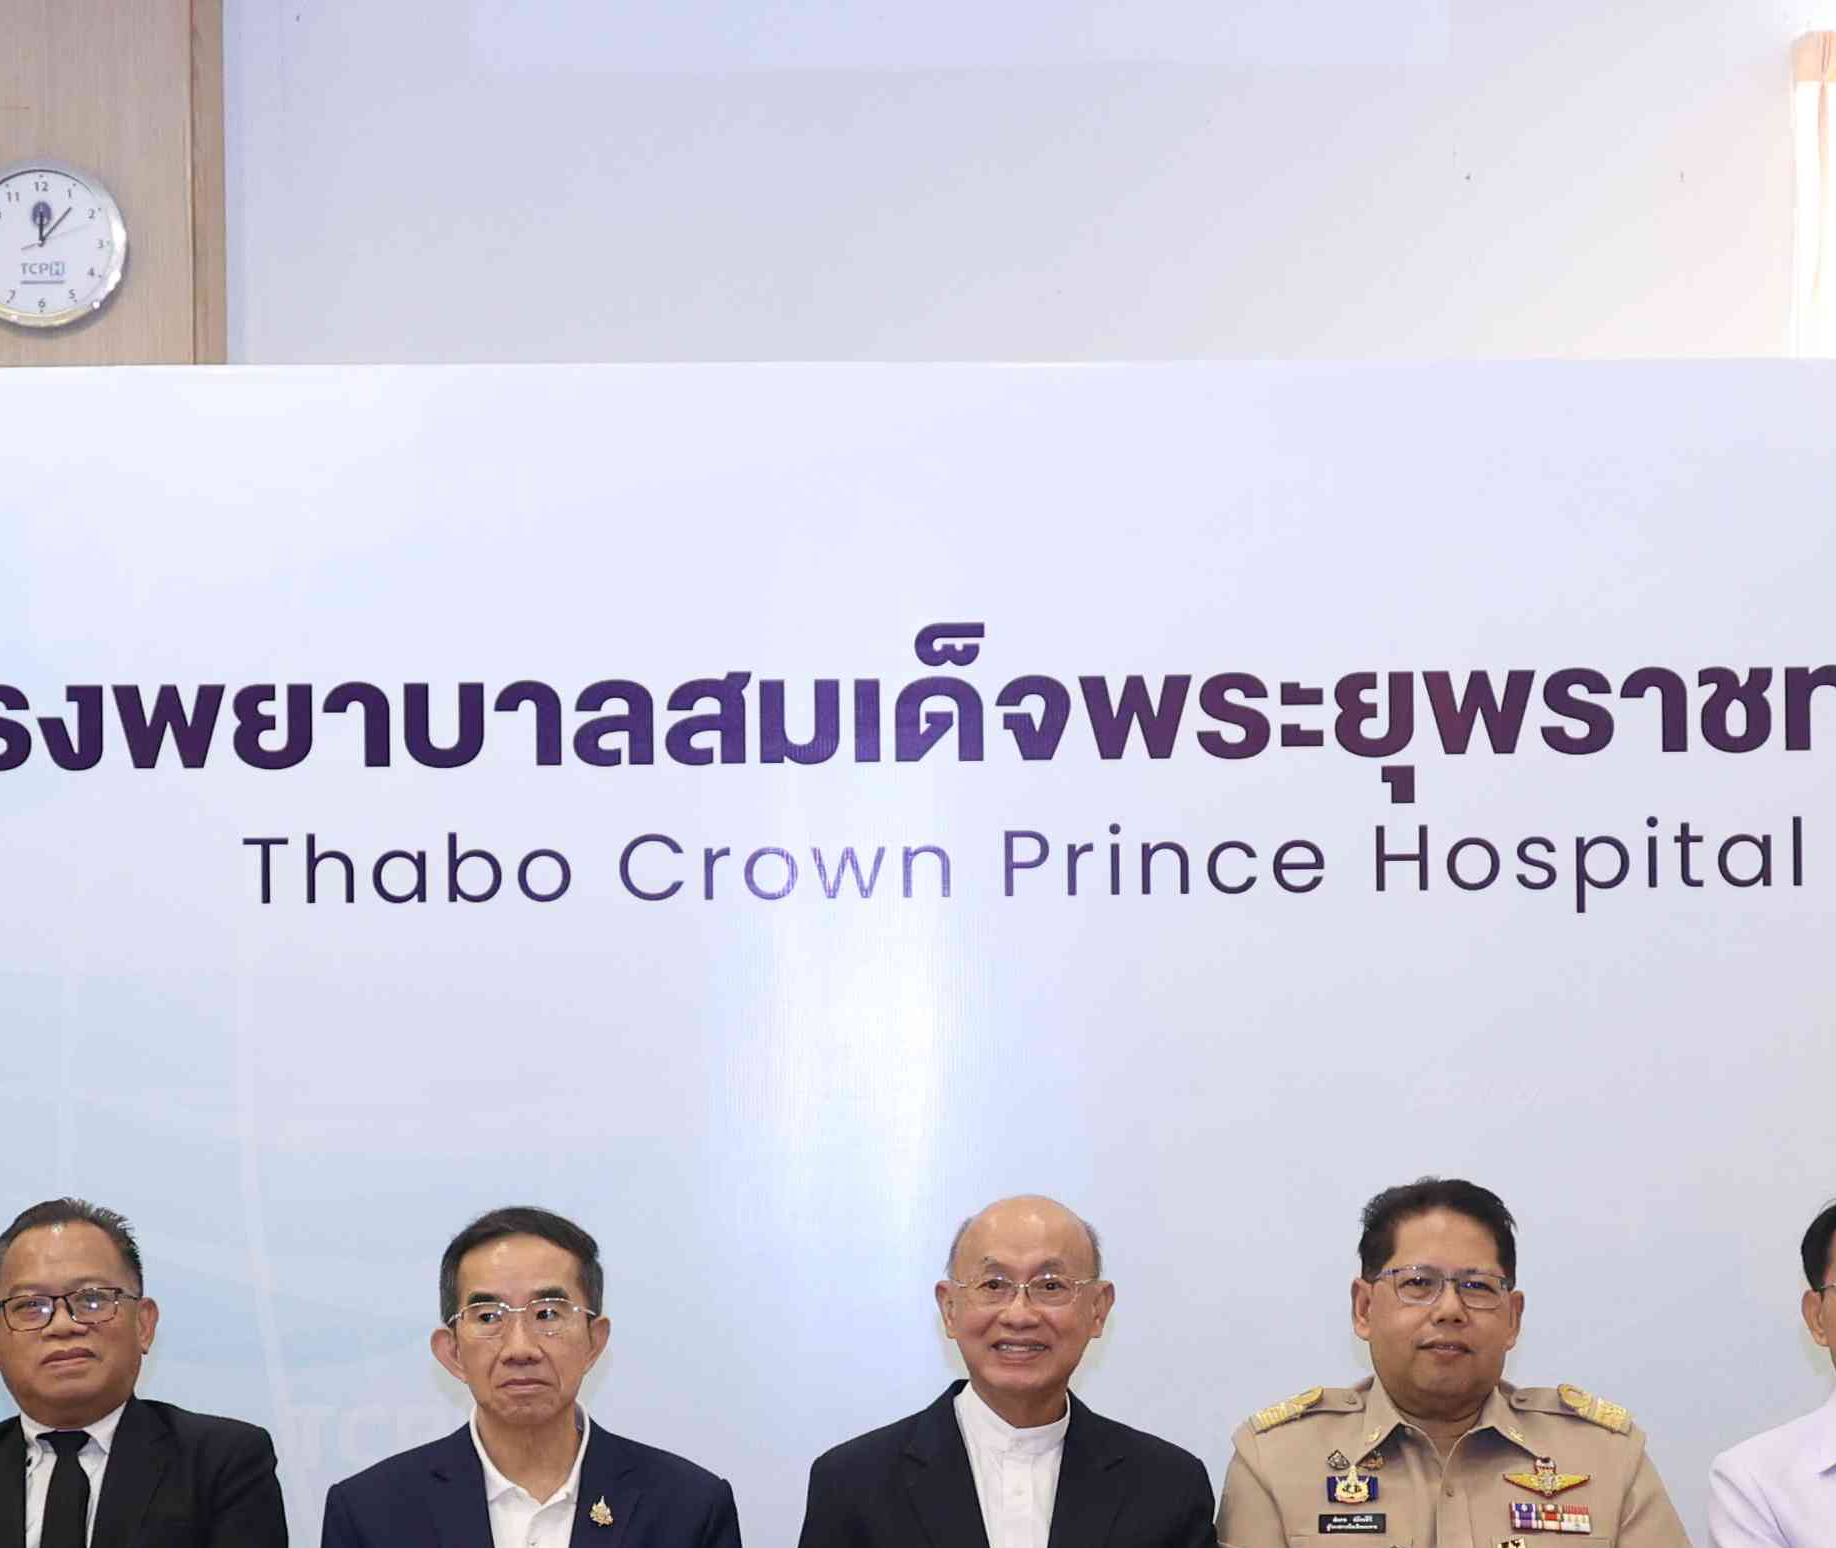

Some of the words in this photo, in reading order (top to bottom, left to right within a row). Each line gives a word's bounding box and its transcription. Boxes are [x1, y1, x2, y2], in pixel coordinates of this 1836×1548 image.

[34, 182, 49, 192] 12
[7, 192, 21, 202] 11
[38, 298, 46, 308] 6
[242, 831, 572, 905] Thabo
[618, 832, 953, 902] Crown
[1003, 823, 1325, 897] Prince
[1375, 815, 1803, 914] Hospital
